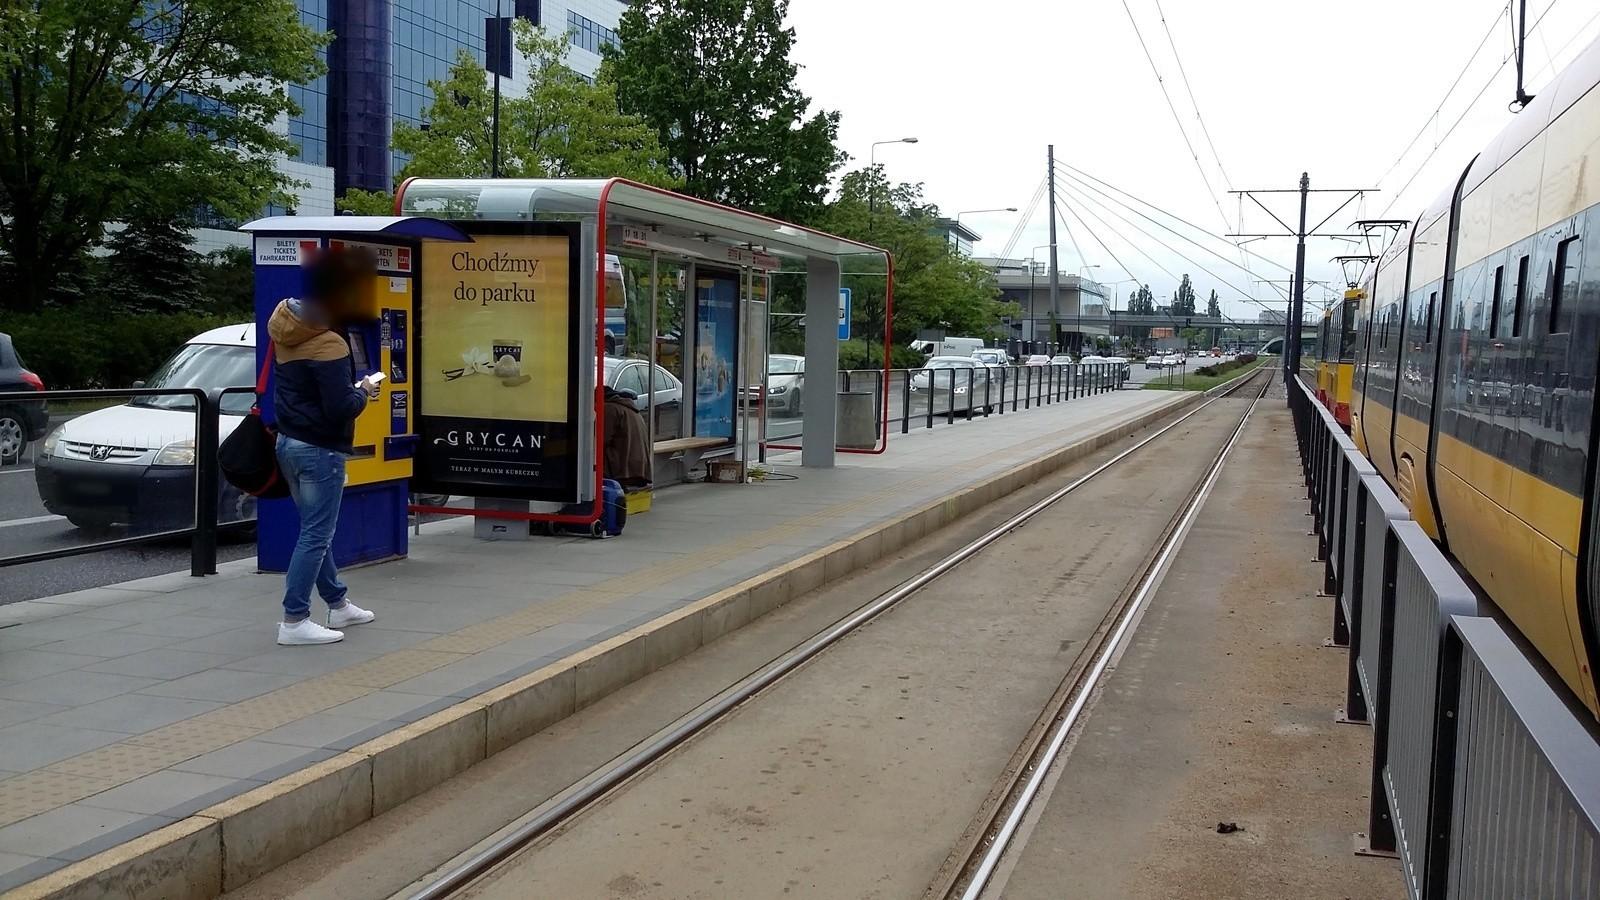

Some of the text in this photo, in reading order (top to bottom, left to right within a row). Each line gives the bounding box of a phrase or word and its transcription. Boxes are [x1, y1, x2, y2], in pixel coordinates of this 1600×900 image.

[625, 229, 631, 238] 17
[451, 251, 539, 278] Chodźmy
[454, 281, 536, 306] do parku
[433, 430, 541, 448] GRYCAN
